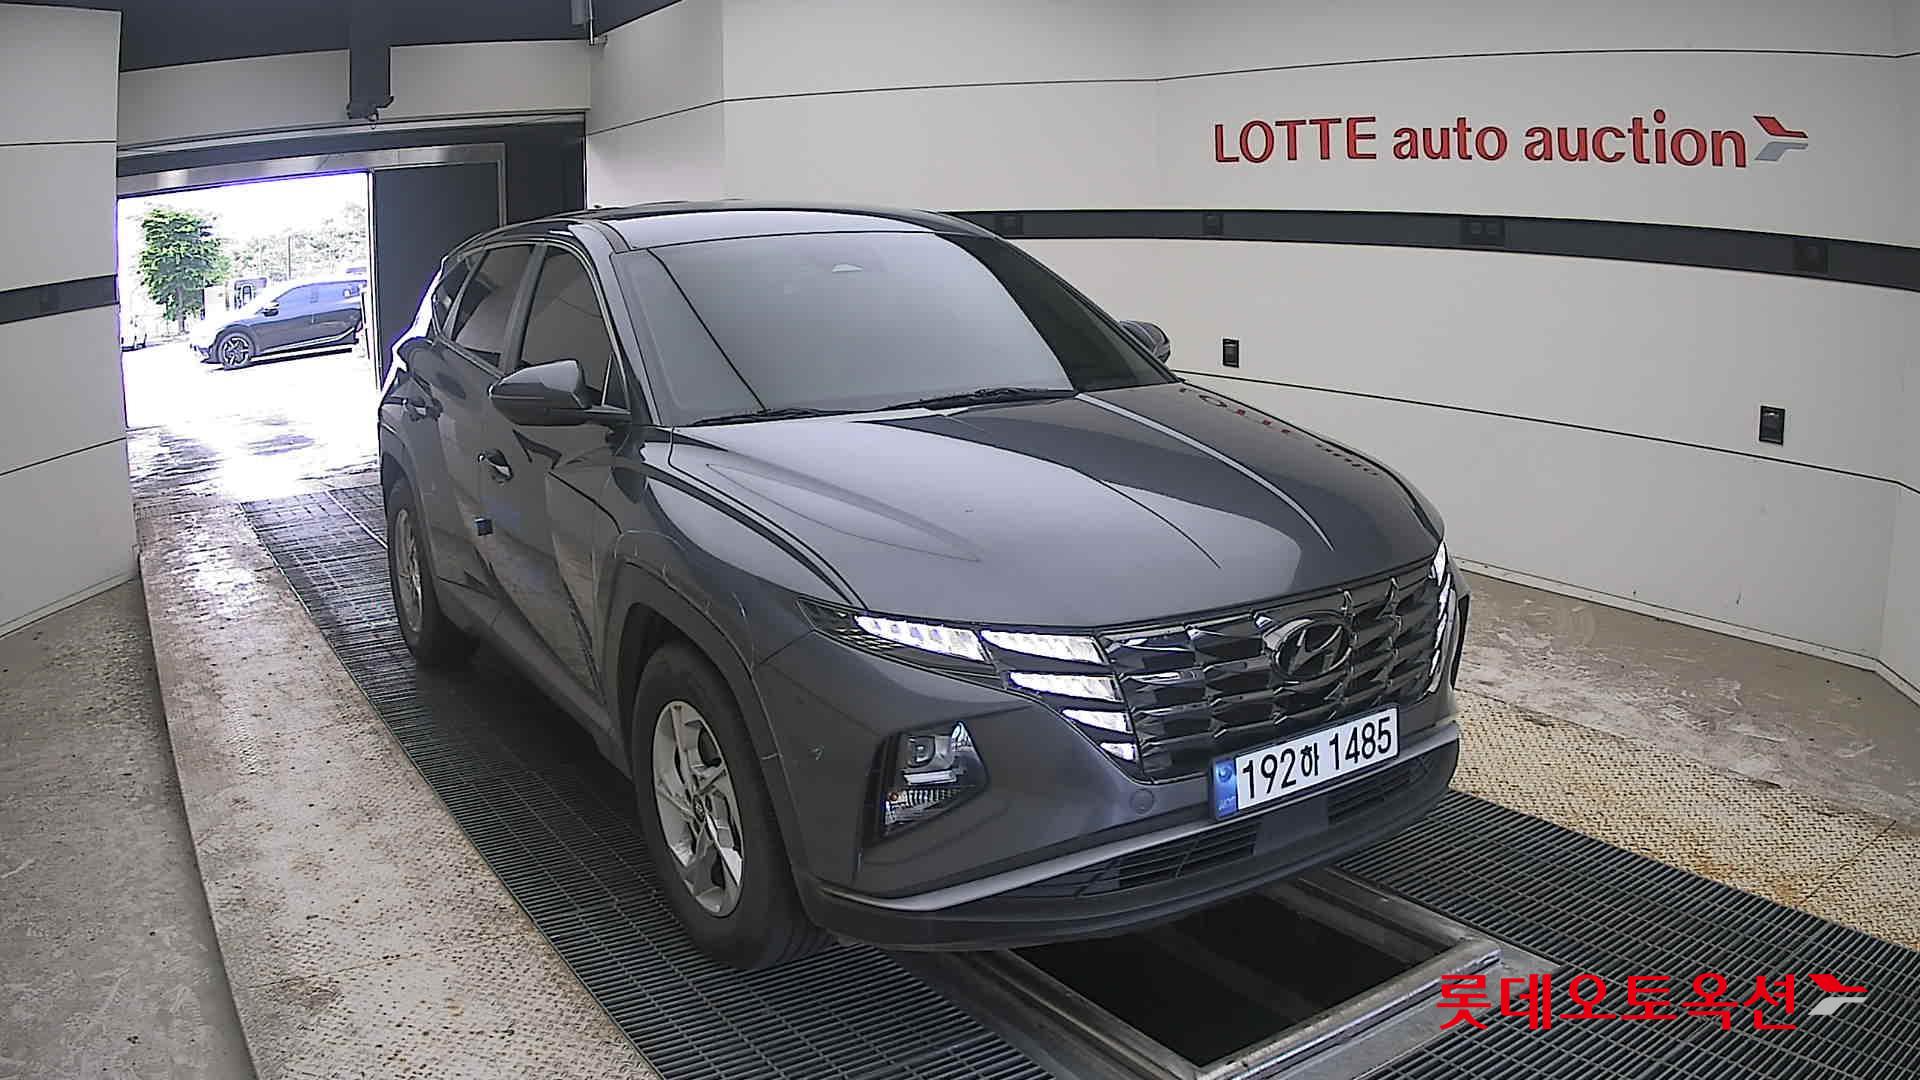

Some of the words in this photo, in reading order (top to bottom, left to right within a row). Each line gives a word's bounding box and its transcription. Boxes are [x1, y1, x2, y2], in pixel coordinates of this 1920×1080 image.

[1214, 116, 1377, 164] LOTTE
[1392, 117, 1508, 161] auto
[1523, 109, 1747, 167] auction
[1242, 742, 1320, 799] 192하
[1328, 716, 1392, 770] 1485
